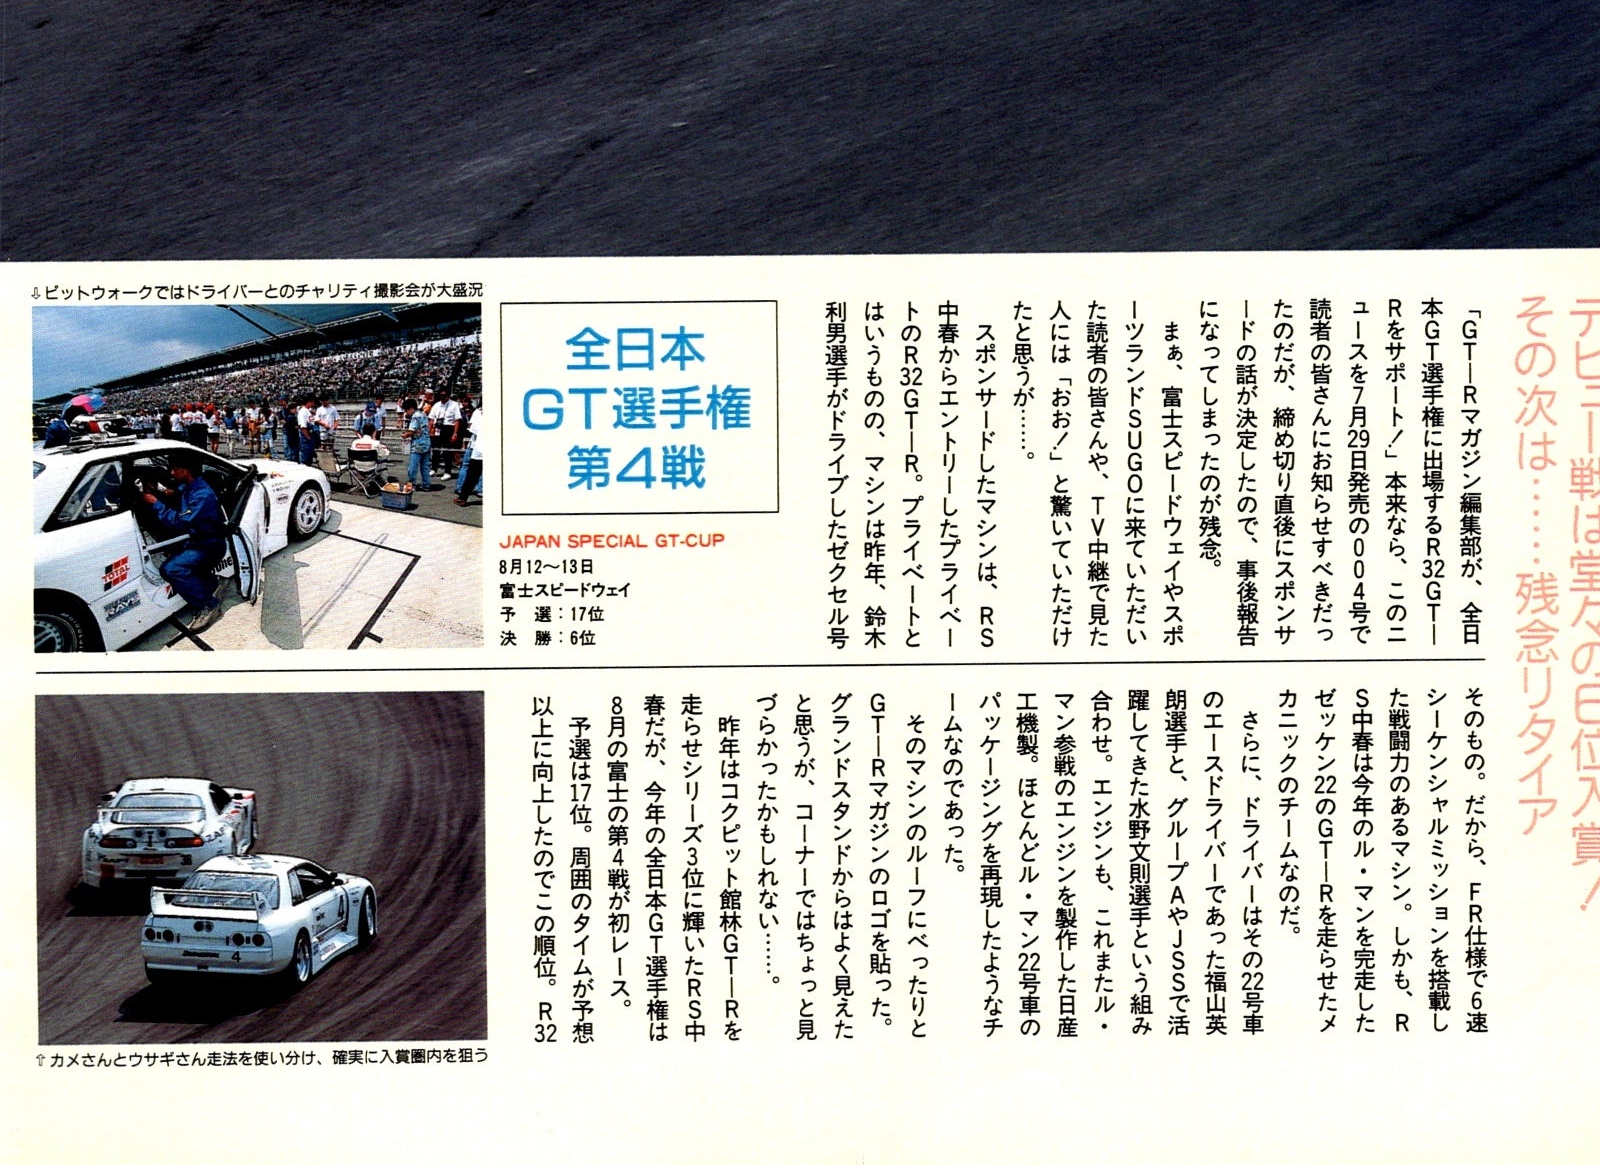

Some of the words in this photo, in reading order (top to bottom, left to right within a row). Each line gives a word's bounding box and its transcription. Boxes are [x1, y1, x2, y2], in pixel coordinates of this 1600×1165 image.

[45, 281, 484, 301] ピットウォークではドライバーとのチャリティ撮影会が大盛況
[522, 383, 752, 431] GT選手権
[564, 325, 706, 372] 全日本
[1198, 300, 1222, 568] になってしまったのが残念。
[102, 564, 131, 583] TOTAL
[499, 533, 561, 550] JAPAN
[567, 533, 649, 549] SPECIAL
[654, 532, 726, 549] GT-CUP
[499, 581, 631, 600] 富士スピードウェイ
[566, 443, 707, 491] 第4戦
[824, 301, 850, 650] 利男選手がドライブしたゼクセル号
[863, 301, 887, 649] はいうものの、マシンは昨年、鈴木
[975, 324, 998, 648] スポンサードしたマシンは、RS
[1086, 299, 1110, 647] た読者の皆さんや、TV中継で見た
[1161, 321, 1185, 646] まぁ、富士スピードウェイやスポ
[1272, 298, 1296, 645] たのだが、締め切り直後にスポンサ
[1309, 297, 1334, 642] 読者の皆さんにお知らせすべきだっ
[1347, 301, 1372, 645] ュースを7月29日発売の004号で
[231, 950, 242, 963] 4
[531, 696, 557, 1043] 以上に向上したのでこの順位。R32
[568, 716, 595, 1044] 予選は17位。周囲のタイムが予想
[606, 695, 632, 1008] 8月の富士の第4戦が初レース。
[643, 693, 669, 1042] 春だが、今年の全日本GT選手権は
[680, 693, 706, 1043] 走らせシリーズ3位に輝いたRS中
[792, 693, 818, 1041] と思うが、コーナーではちょっと見
[831, 692, 855, 1040] グランドスタンドからはよく見えた
[905, 714, 929, 1038] そのマシンのルーフにべったりと
[979, 691, 1004, 1038] パッケージングを再現したようなチ
[1052, 693, 1079, 1038] マン参戦のエンジンを製作した日産
[1127, 689, 1154, 1036] 躍してきた水野文則選手という組み
[1164, 688, 1191, 1036] 朗選手と、グループAやJSSで活
[1203, 691, 1228, 1036] のエースドライバーであった福山英
[1241, 710, 1265, 1036] さらに、ドライバーはその22号車
[1277, 688, 1301, 934] カニックのチームなのだ。
[1388, 687, 1413, 1032] た戦闘力のあるマシン。しかも、R
[1426, 688, 1452, 1032] シーケンシャルミッションを搭載し
[1463, 687, 1489, 1033] そのもの。だから、FR仕様で6速
[49, 1048, 488, 1068] カメさんとウサギさん走法を使い分け、確実に入賞圏内を狙う
